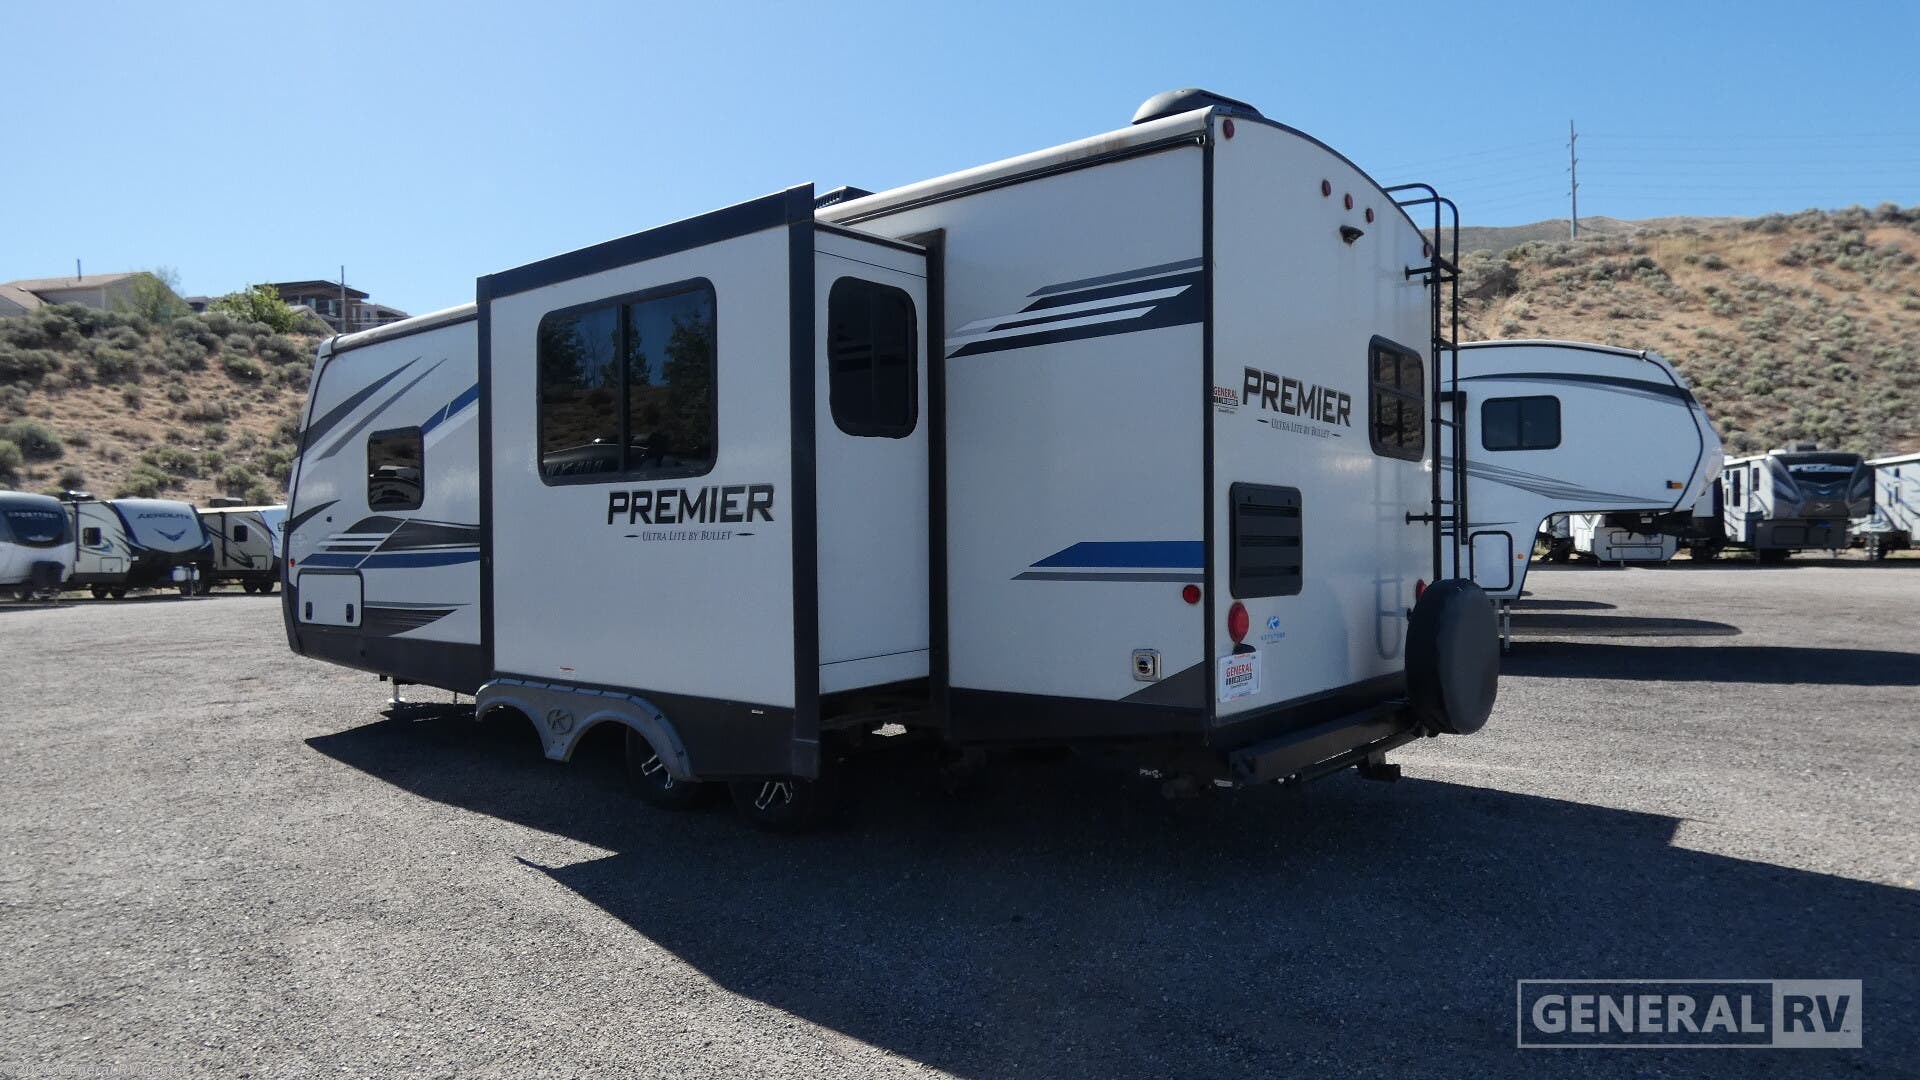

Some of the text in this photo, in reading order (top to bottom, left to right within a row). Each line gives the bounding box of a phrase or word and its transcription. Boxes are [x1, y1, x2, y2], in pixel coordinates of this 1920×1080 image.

[1214, 386, 1238, 399] GENERAL
[1243, 367, 1351, 428] PREMIER
[608, 485, 774, 525] PREMIER
[642, 531, 667, 541] ULTRA
[668, 530, 686, 541] LITE
[700, 530, 732, 541] BULLET
[1226, 663, 1252, 676] GENERAL
